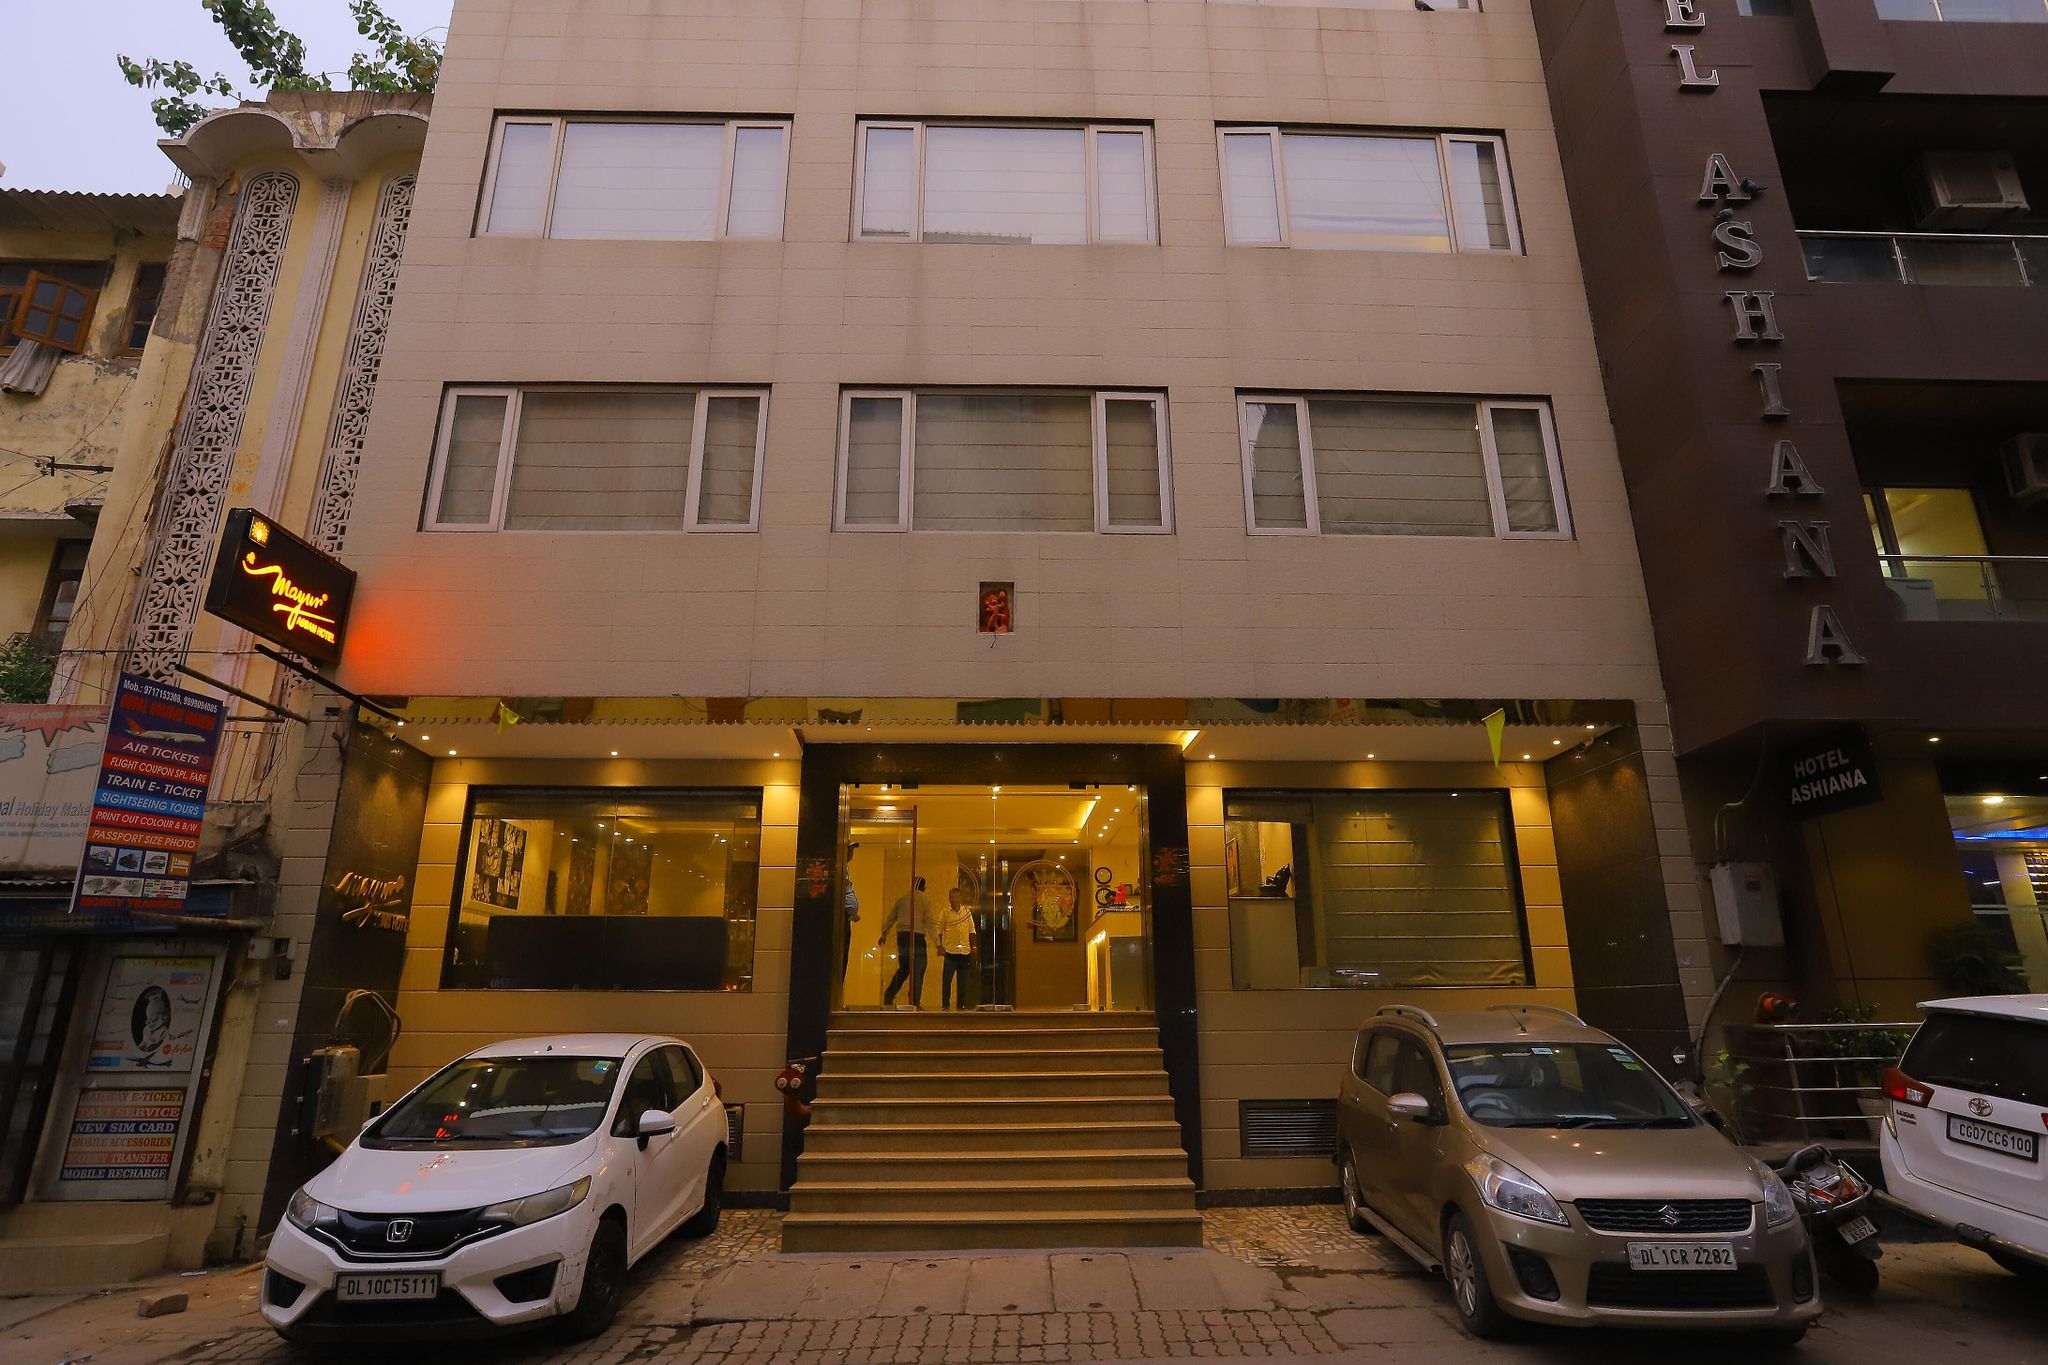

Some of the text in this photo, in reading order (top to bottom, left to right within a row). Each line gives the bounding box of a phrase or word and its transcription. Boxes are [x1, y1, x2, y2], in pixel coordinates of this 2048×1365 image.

[1698, 153, 1867, 667] ASHIANA
[122, 742, 200, 765] AIR TICKETS
[110, 757, 139, 770] FLIGHT
[139, 762, 175, 777] COUPON
[189, 772, 207, 783] FARE
[1791, 748, 1867, 806] HOTEL ASHIANA
[107, 774, 146, 790] TRAIN
[164, 784, 202, 799] TICKET
[16, 802, 58, 820] Holiday
[100, 793, 200, 816] SIGHTSEEING TOURS
[95, 811, 121, 822] PRINT
[121, 814, 140, 824] OUT
[140, 816, 174, 829] COLOUR
[181, 822, 198, 832] B/W
[92, 830, 143, 844] PASSPORT
[144, 835, 162, 846] SIZE
[164, 837, 196, 849] PHOTO
[119, 1107, 180, 1118] SERVICE
[75, 1123, 175, 1133] NEW SIM CARD
[1959, 1123, 2032, 1153] CG07CC6100
[111, 1137, 172, 1147] ACCESSORIES
[111, 1153, 169, 1163] TRANSFER
[62, 1169, 167, 1179] MOBILE RECHARGE
